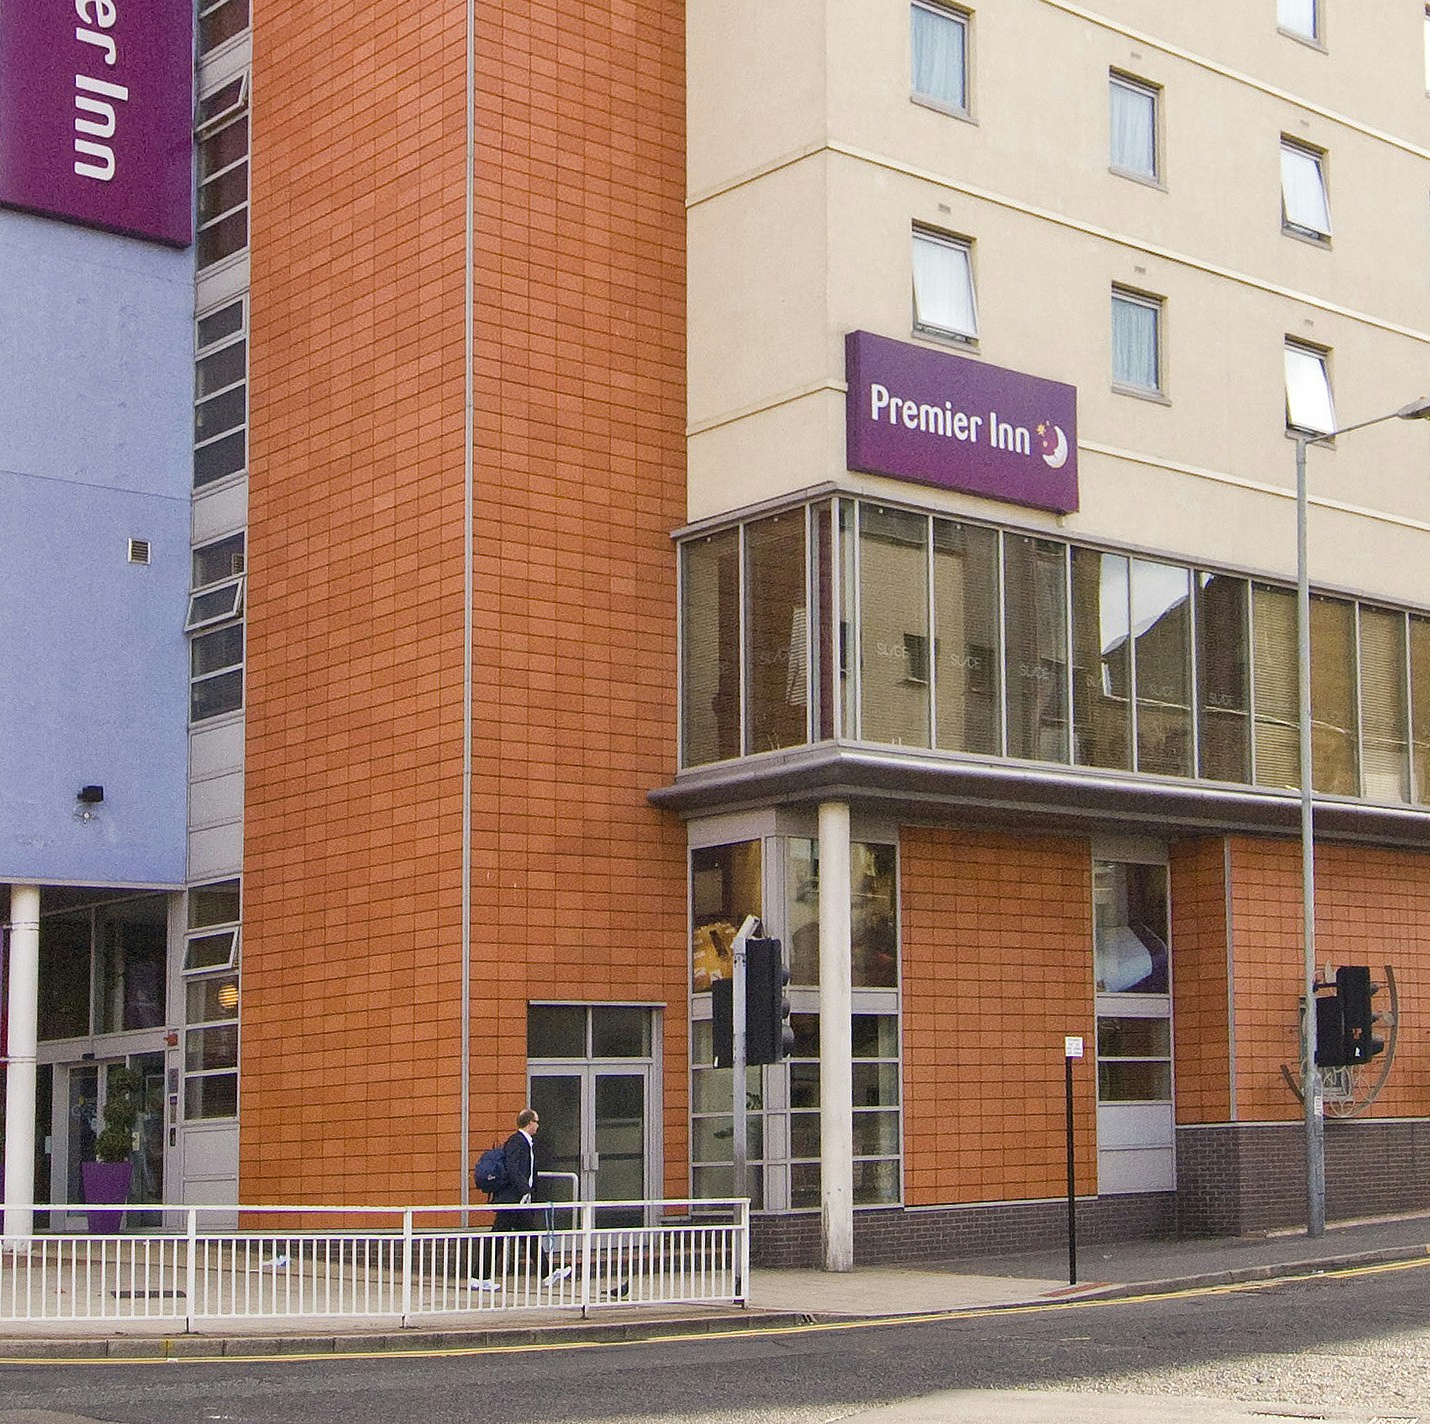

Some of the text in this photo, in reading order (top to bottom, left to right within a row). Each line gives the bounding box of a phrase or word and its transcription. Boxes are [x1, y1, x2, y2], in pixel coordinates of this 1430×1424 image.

[74, 74, 129, 182] Inn
[871, 383, 1031, 456] Premier Inn
